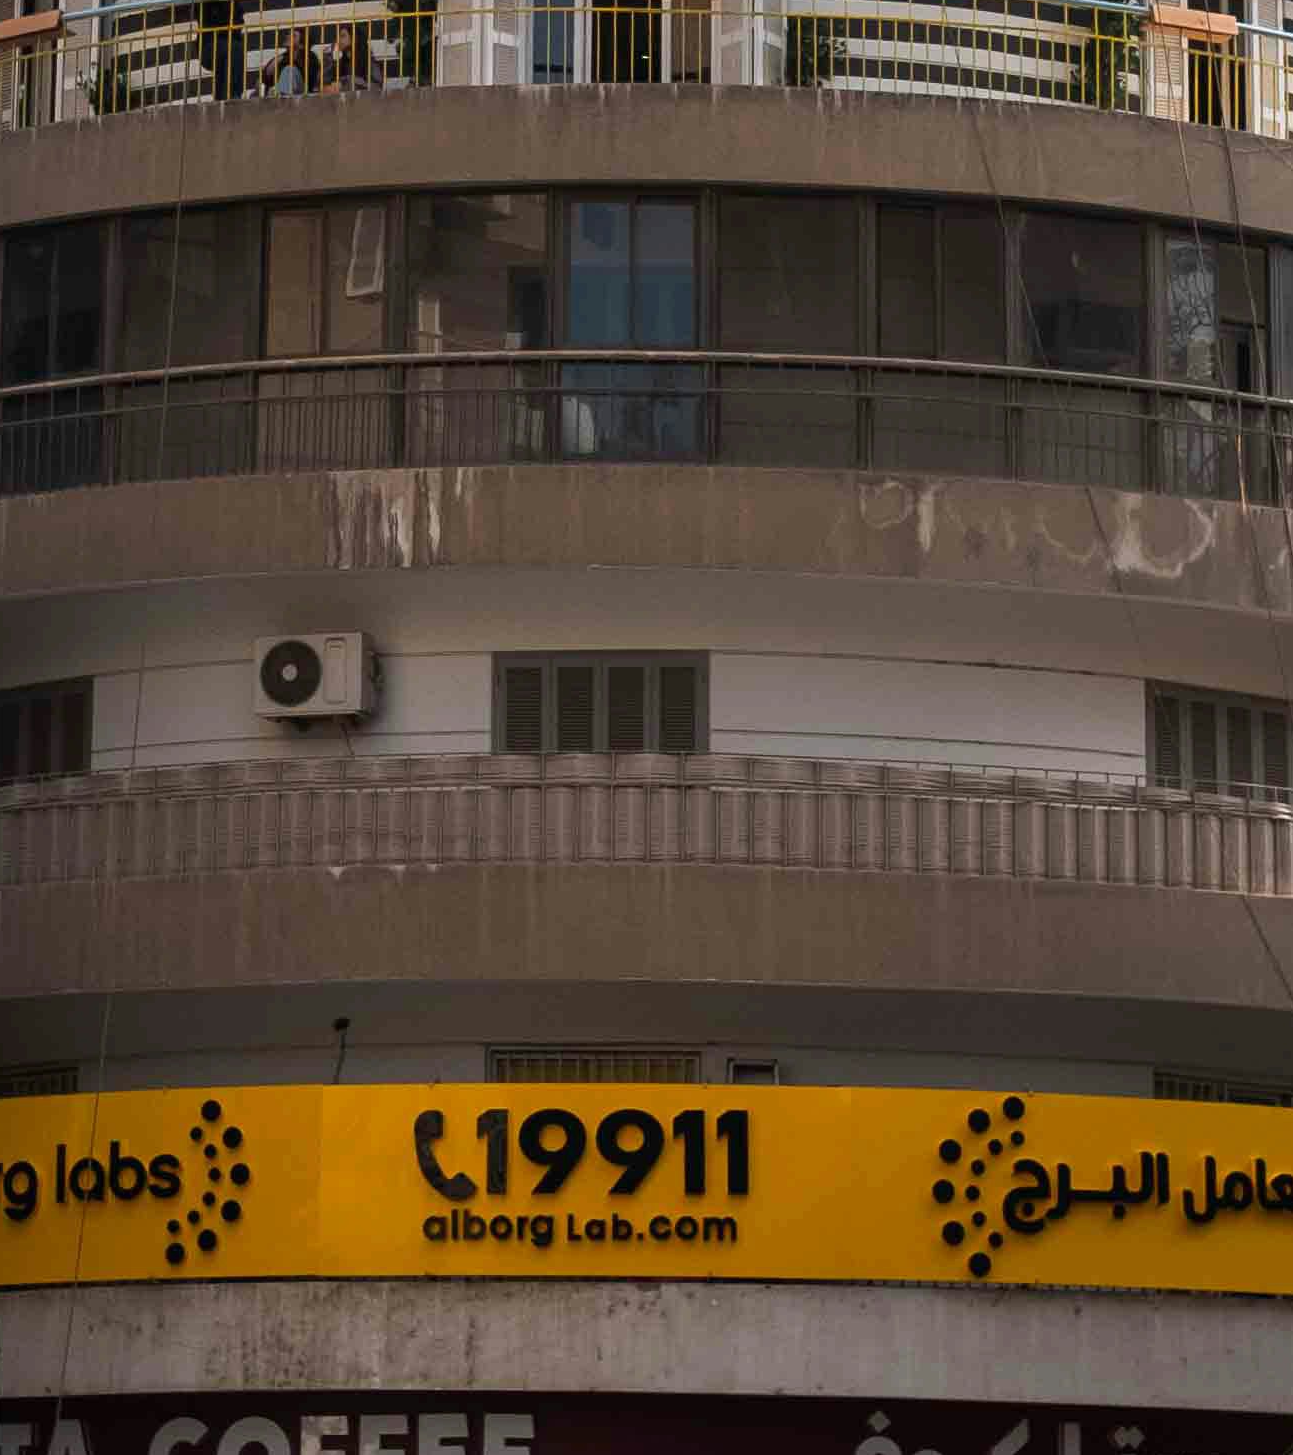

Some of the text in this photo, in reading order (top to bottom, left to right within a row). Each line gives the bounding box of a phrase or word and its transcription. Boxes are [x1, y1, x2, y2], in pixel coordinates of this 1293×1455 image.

[55, 1141, 181, 1203] labs
[476, 1108, 749, 1196] 19911
[422, 1209, 737, 1247] alborg Lab.com
[1002, 1151, 1169, 1233] البرج
